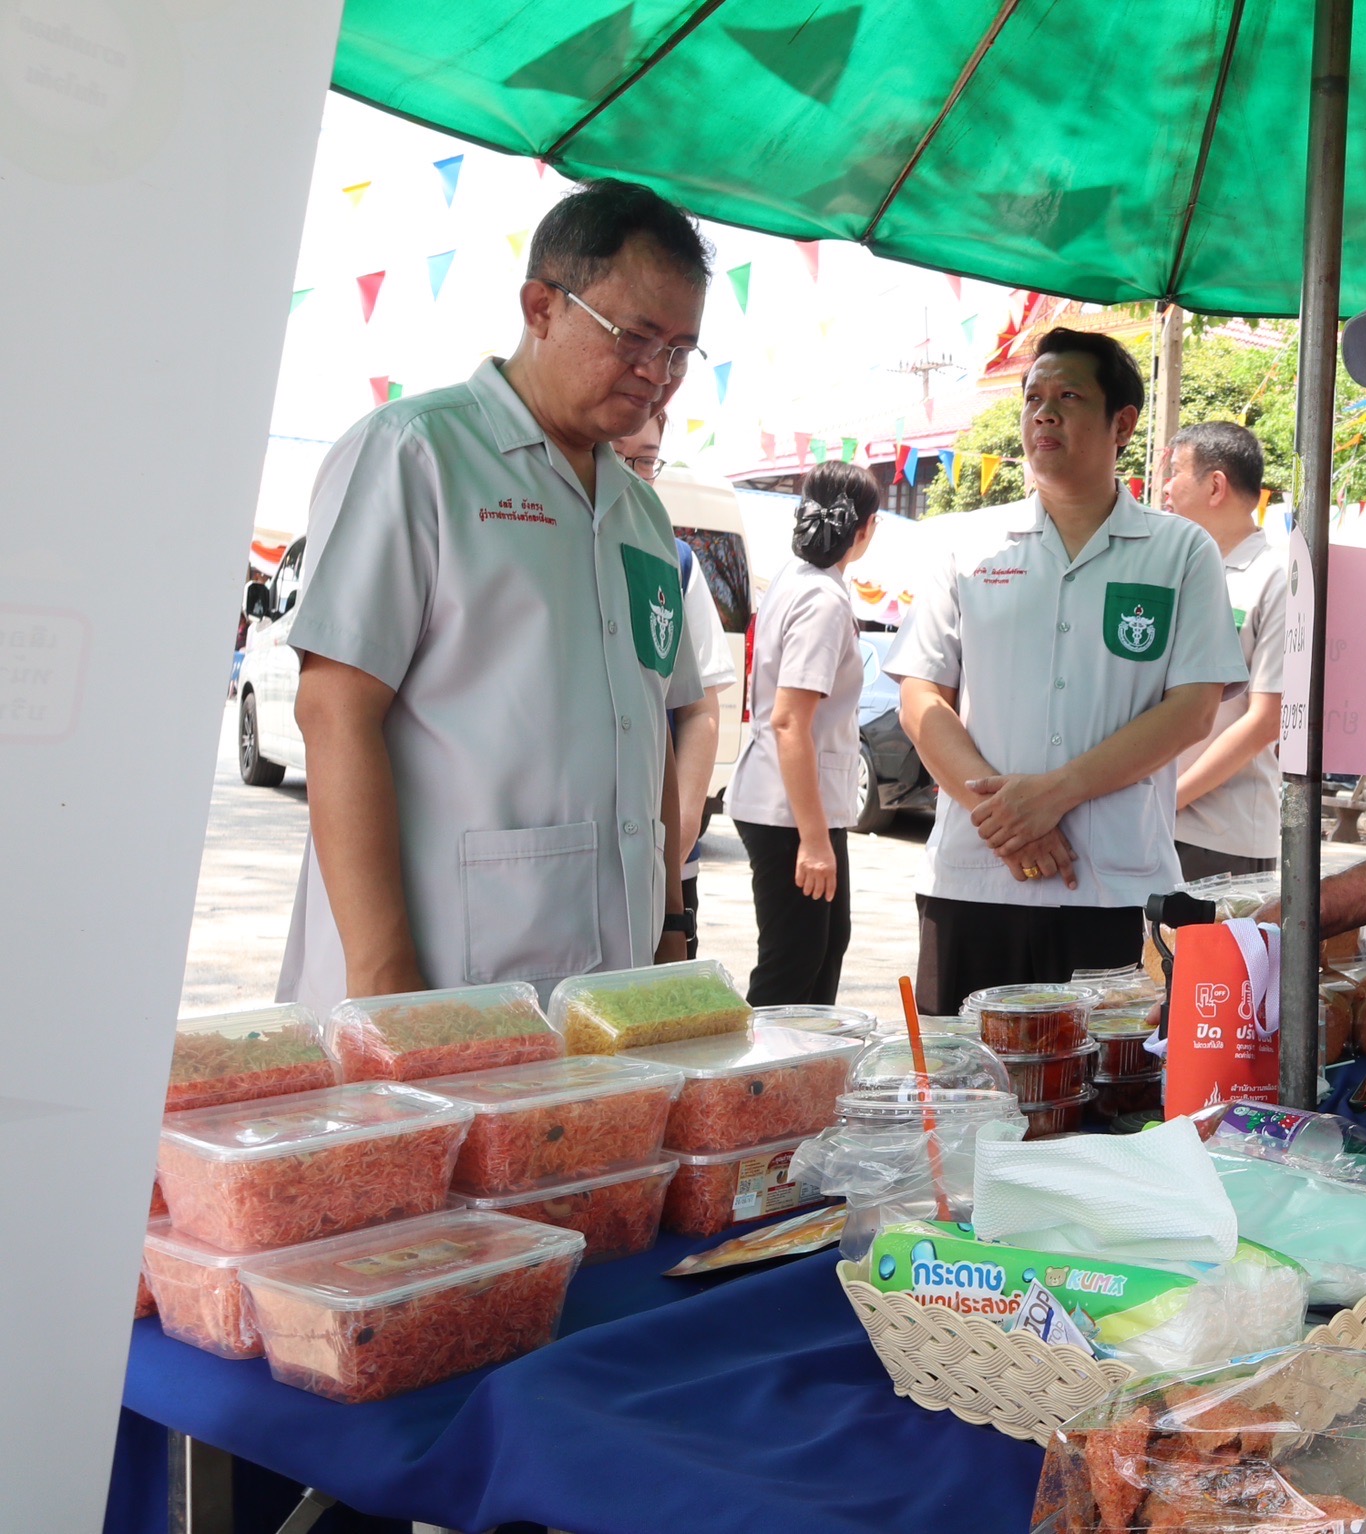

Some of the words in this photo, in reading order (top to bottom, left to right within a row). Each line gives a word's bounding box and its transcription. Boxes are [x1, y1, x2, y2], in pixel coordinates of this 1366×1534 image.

[1197, 1023, 1222, 1039] ปิด
[912, 1262, 1004, 1291] กระดาษ
[1066, 1268, 1128, 1297] KUMA
